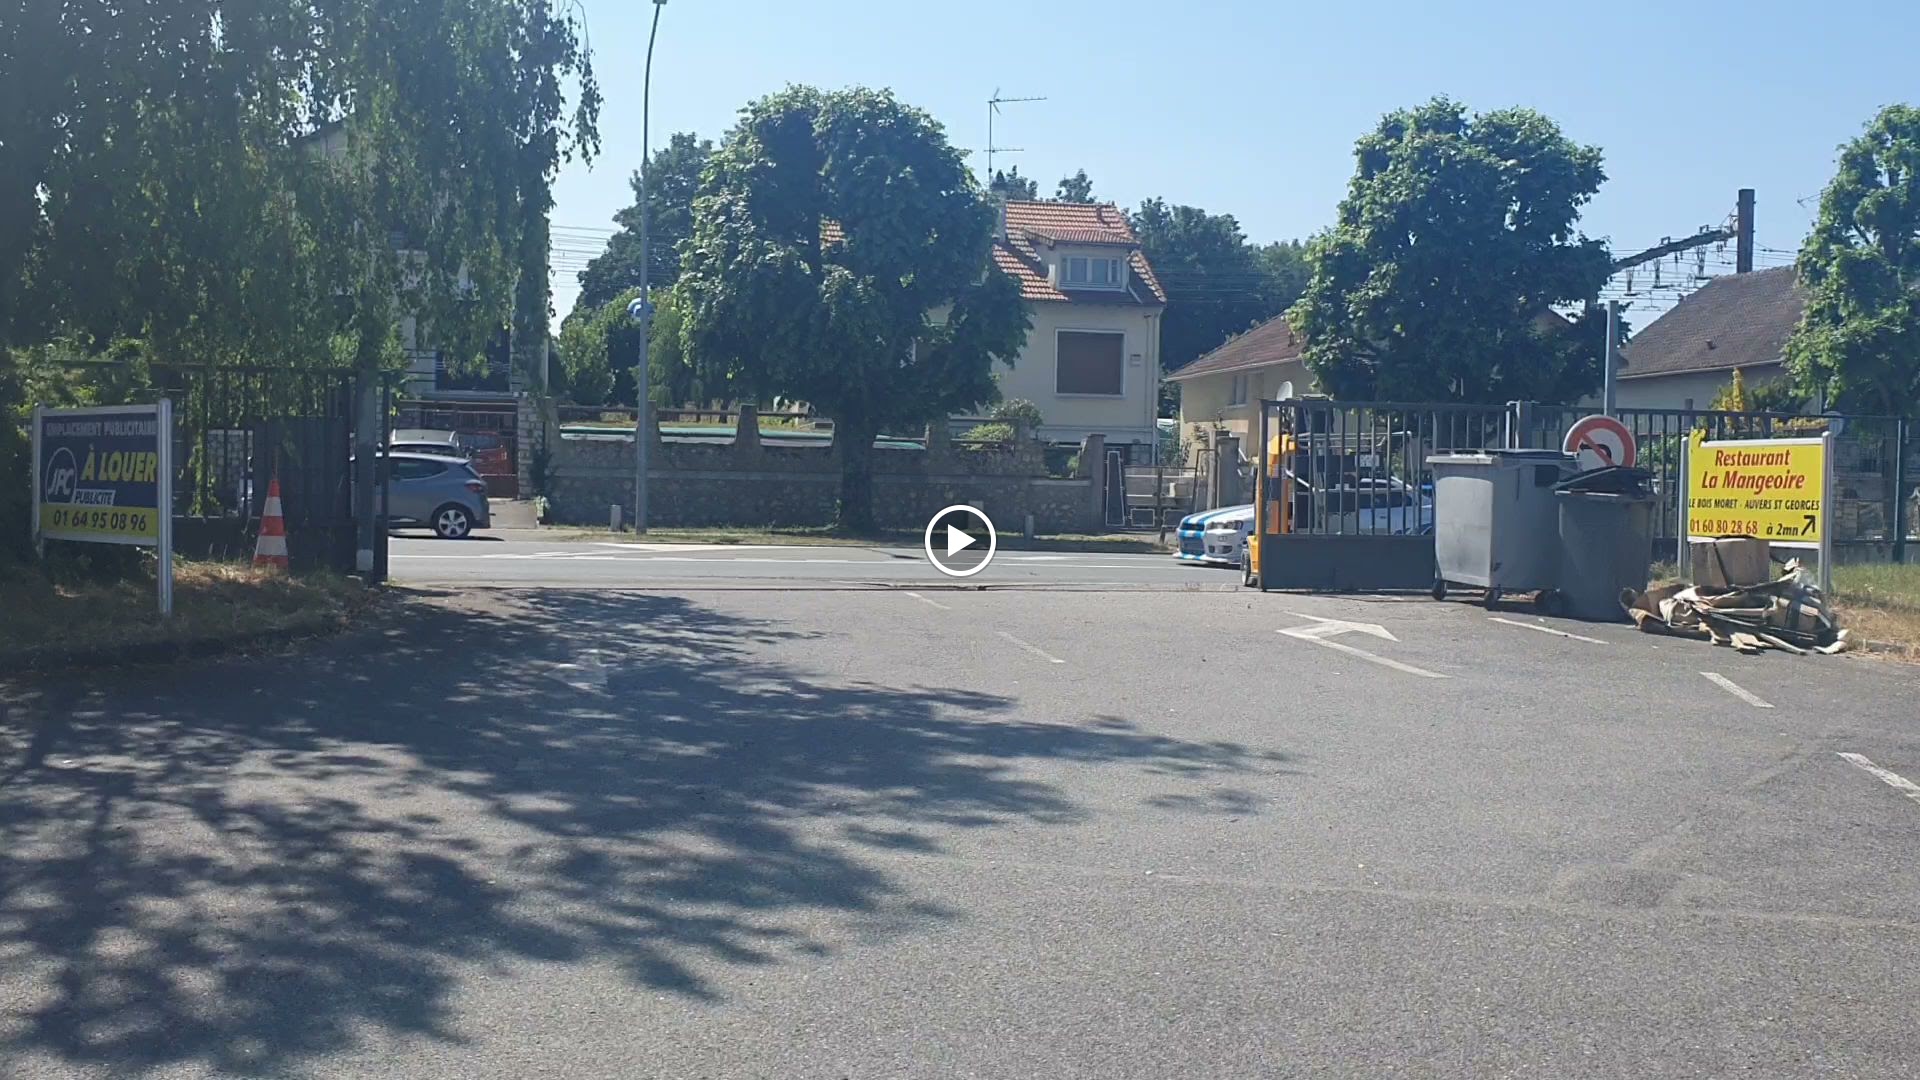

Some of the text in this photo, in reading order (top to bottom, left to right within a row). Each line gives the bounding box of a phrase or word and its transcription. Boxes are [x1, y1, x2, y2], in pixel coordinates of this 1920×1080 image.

[99, 451, 157, 482] LOUER
[1715, 450, 1790, 466] Restaurant
[1701, 469, 1805, 494] La Mangeoire
[1689, 499, 1820, 510] LE BOIS MORET AUVERS ST GEORGES
[54, 510, 147, 531] 01 64 95 08 96
[1690, 519, 1798, 536] 01 60 80 28 68 à 2mn
